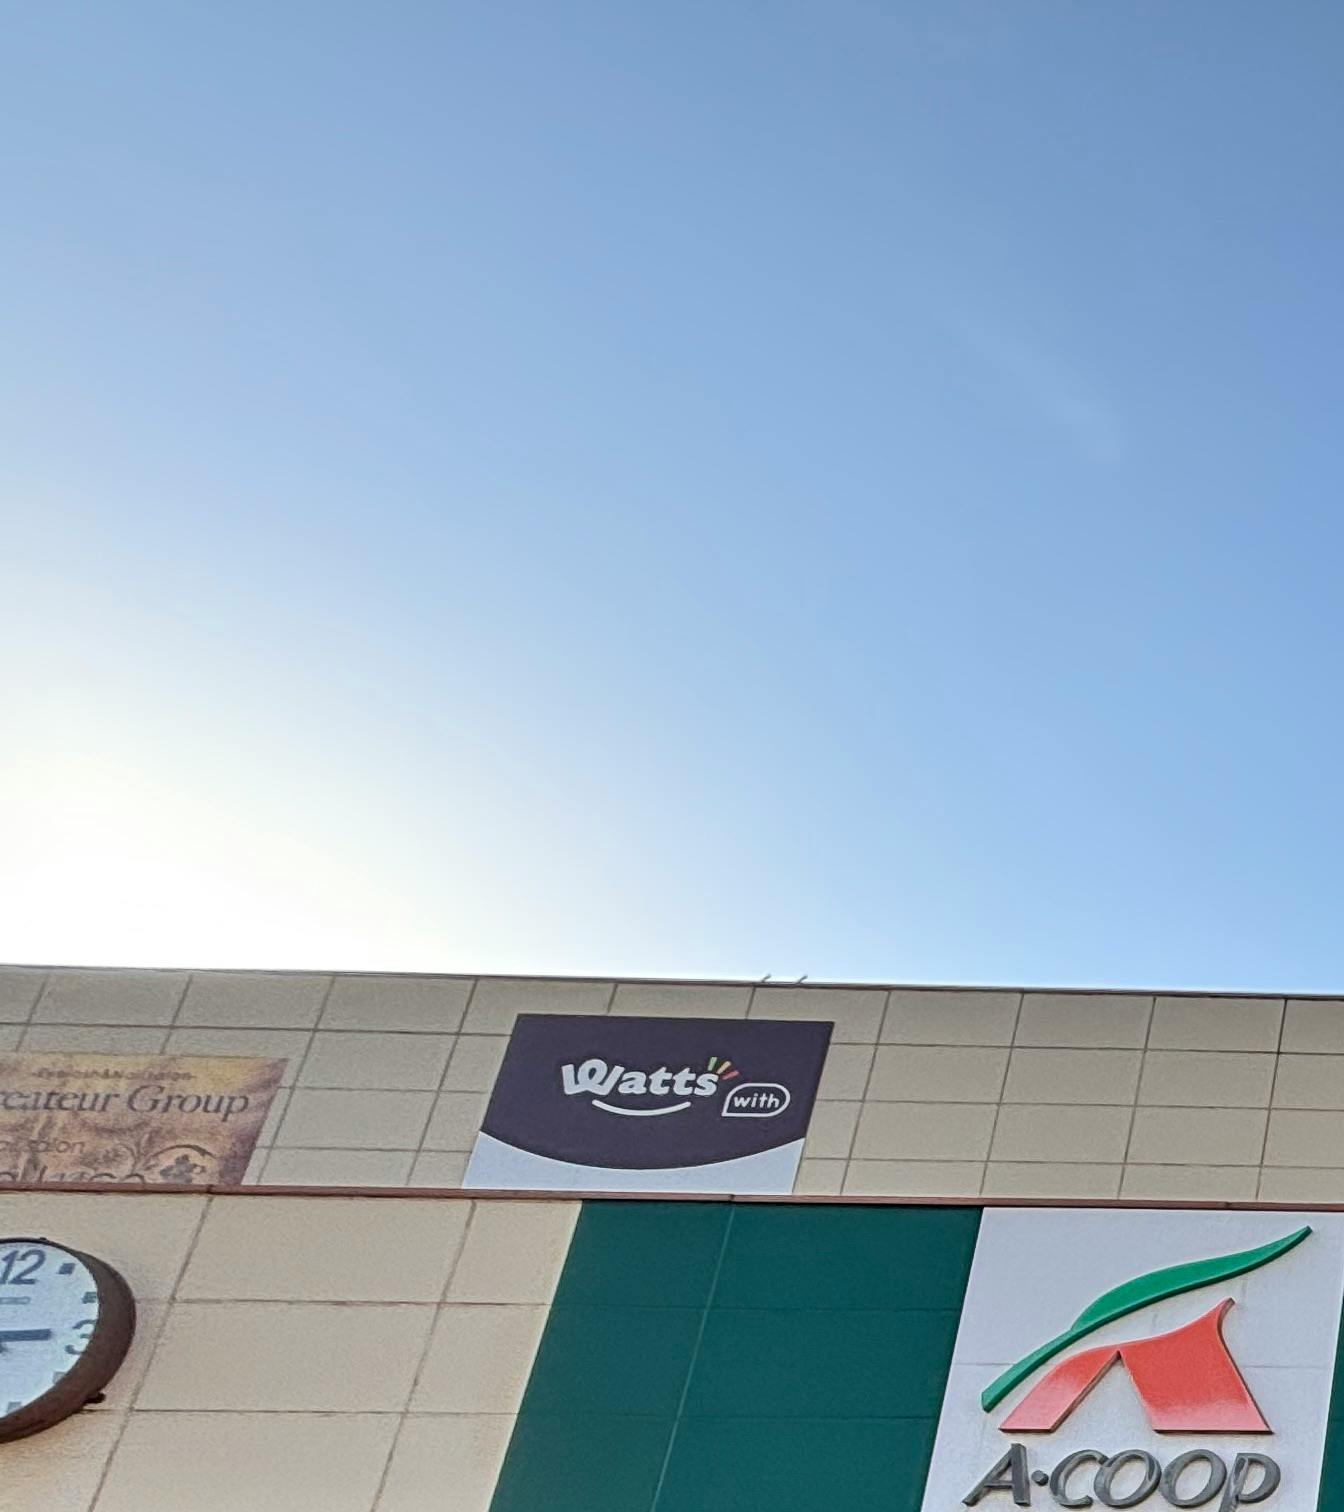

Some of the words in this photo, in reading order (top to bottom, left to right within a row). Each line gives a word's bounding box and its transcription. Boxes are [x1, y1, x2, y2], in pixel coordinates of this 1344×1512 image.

[561, 1059, 719, 1096] Watts
[127, 1085, 249, 1122] Group
[733, 1093, 780, 1109] with
[1, 1250, 46, 1285] 12
